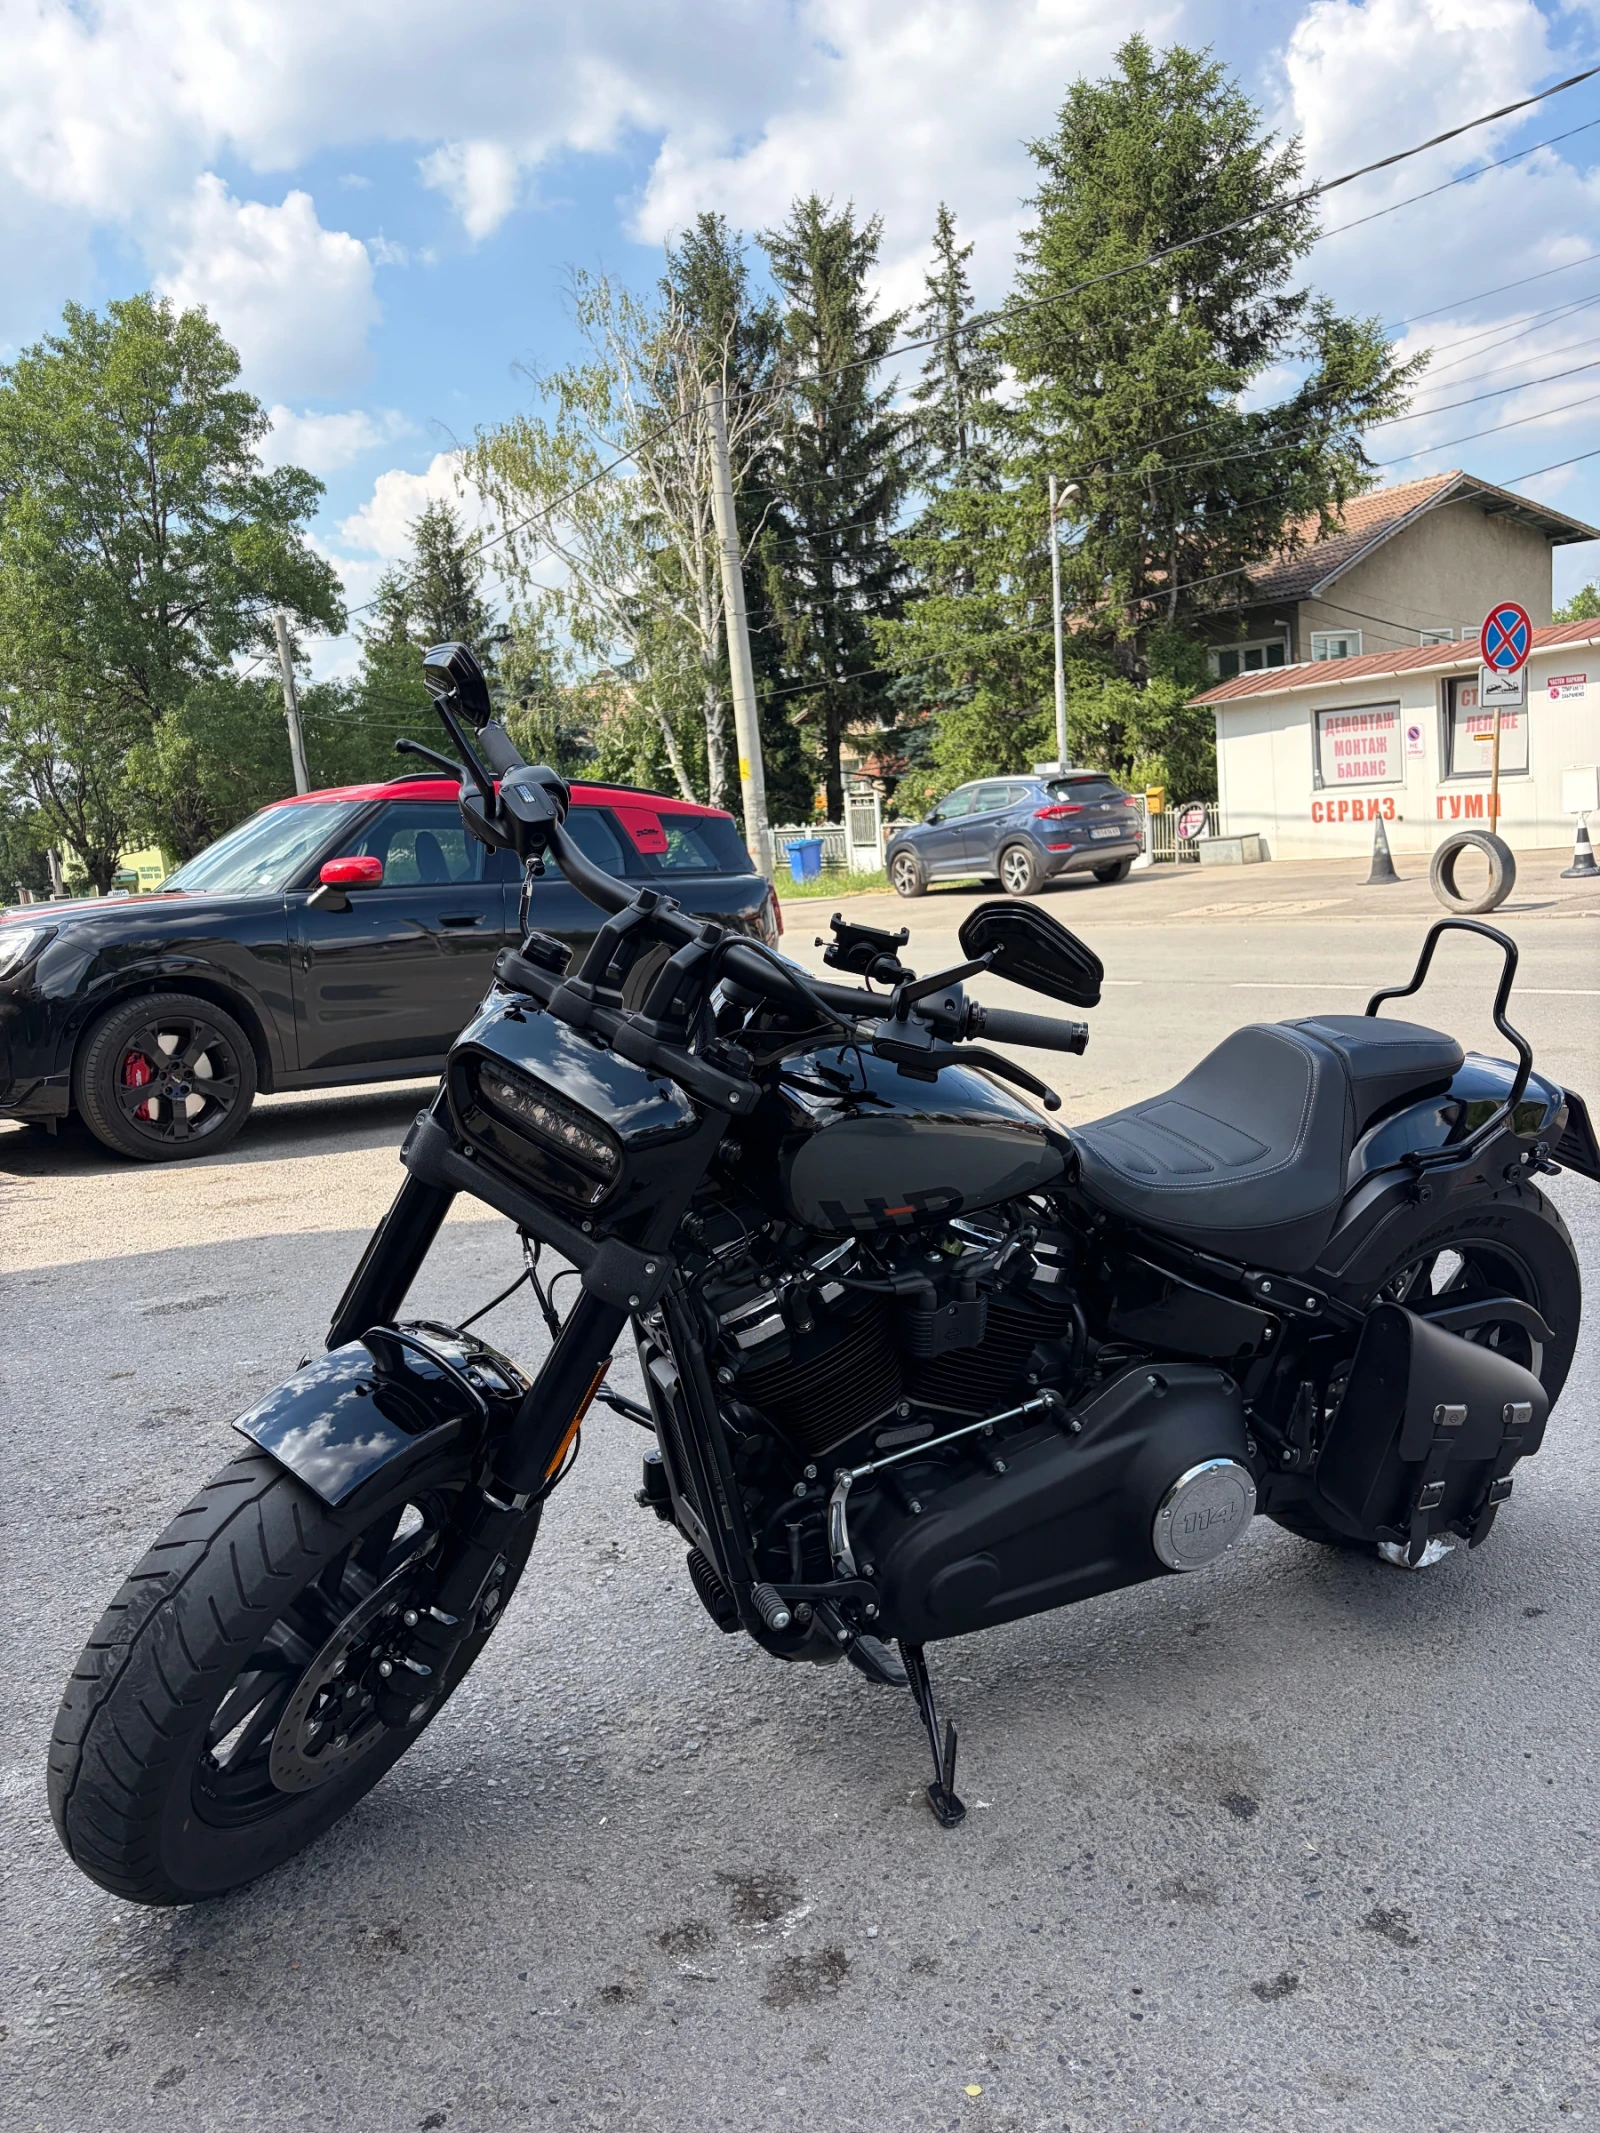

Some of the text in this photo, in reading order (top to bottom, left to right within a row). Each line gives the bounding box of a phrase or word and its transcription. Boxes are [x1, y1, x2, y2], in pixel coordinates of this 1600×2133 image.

[1325, 711, 1395, 737] ДЕМОНТАЖ
[1465, 711, 1519, 733] ЛЕПНЕ
[1334, 736, 1388, 757] МОНТАЖ
[1337, 759, 1387, 779] БАЛАНС
[1311, 797, 1396, 824] СЕРВИЗ
[1183, 1501, 1238, 1534] 114
